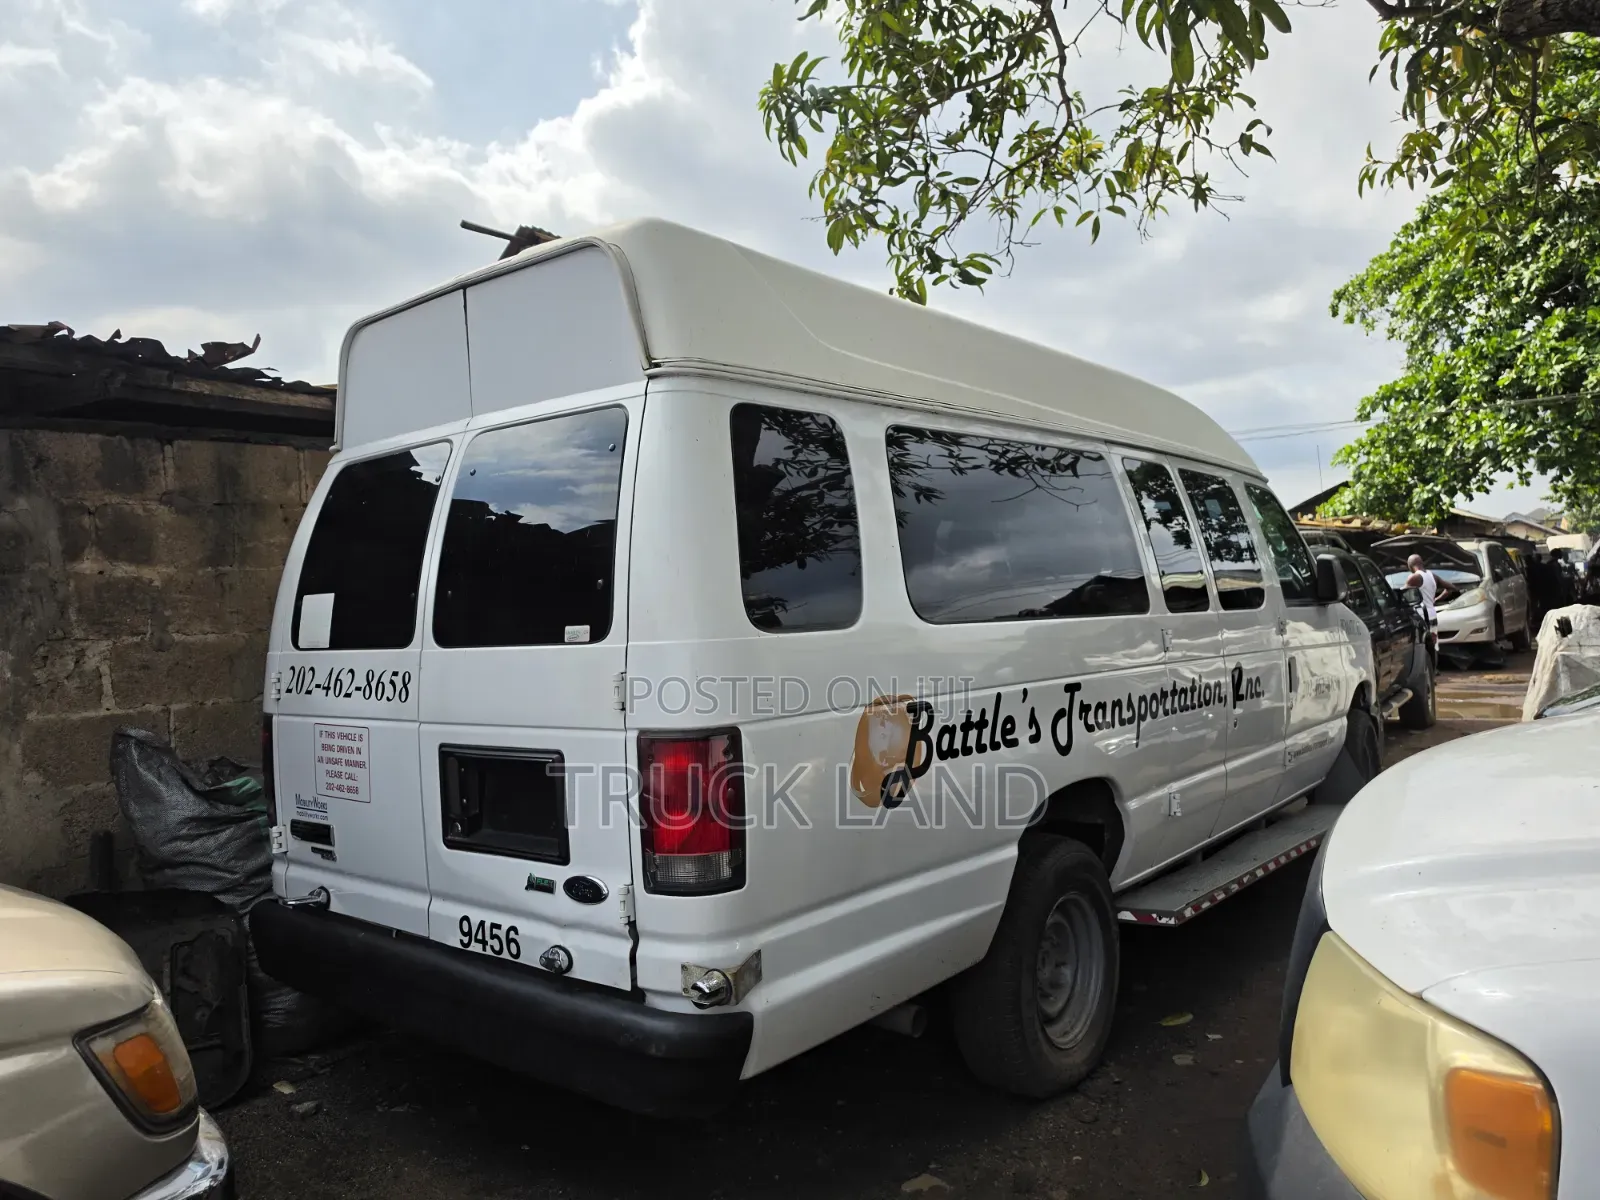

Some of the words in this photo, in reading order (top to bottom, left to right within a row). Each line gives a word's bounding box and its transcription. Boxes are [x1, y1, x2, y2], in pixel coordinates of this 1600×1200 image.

[285, 666, 411, 703] 202-462-8658
[324, 731, 336, 740] THIS
[337, 732, 357, 741] VEHICLE
[358, 734, 364, 742] IS
[321, 743, 335, 753] BEING
[336, 745, 355, 755] DRIVEN
[356, 747, 362, 755] IN
[881, 687, 1042, 809] Battle's
[317, 755, 324, 764] AN
[325, 757, 343, 767] UNSAFE
[325, 770, 343, 780] PLEASE
[458, 914, 521, 960] 9456
